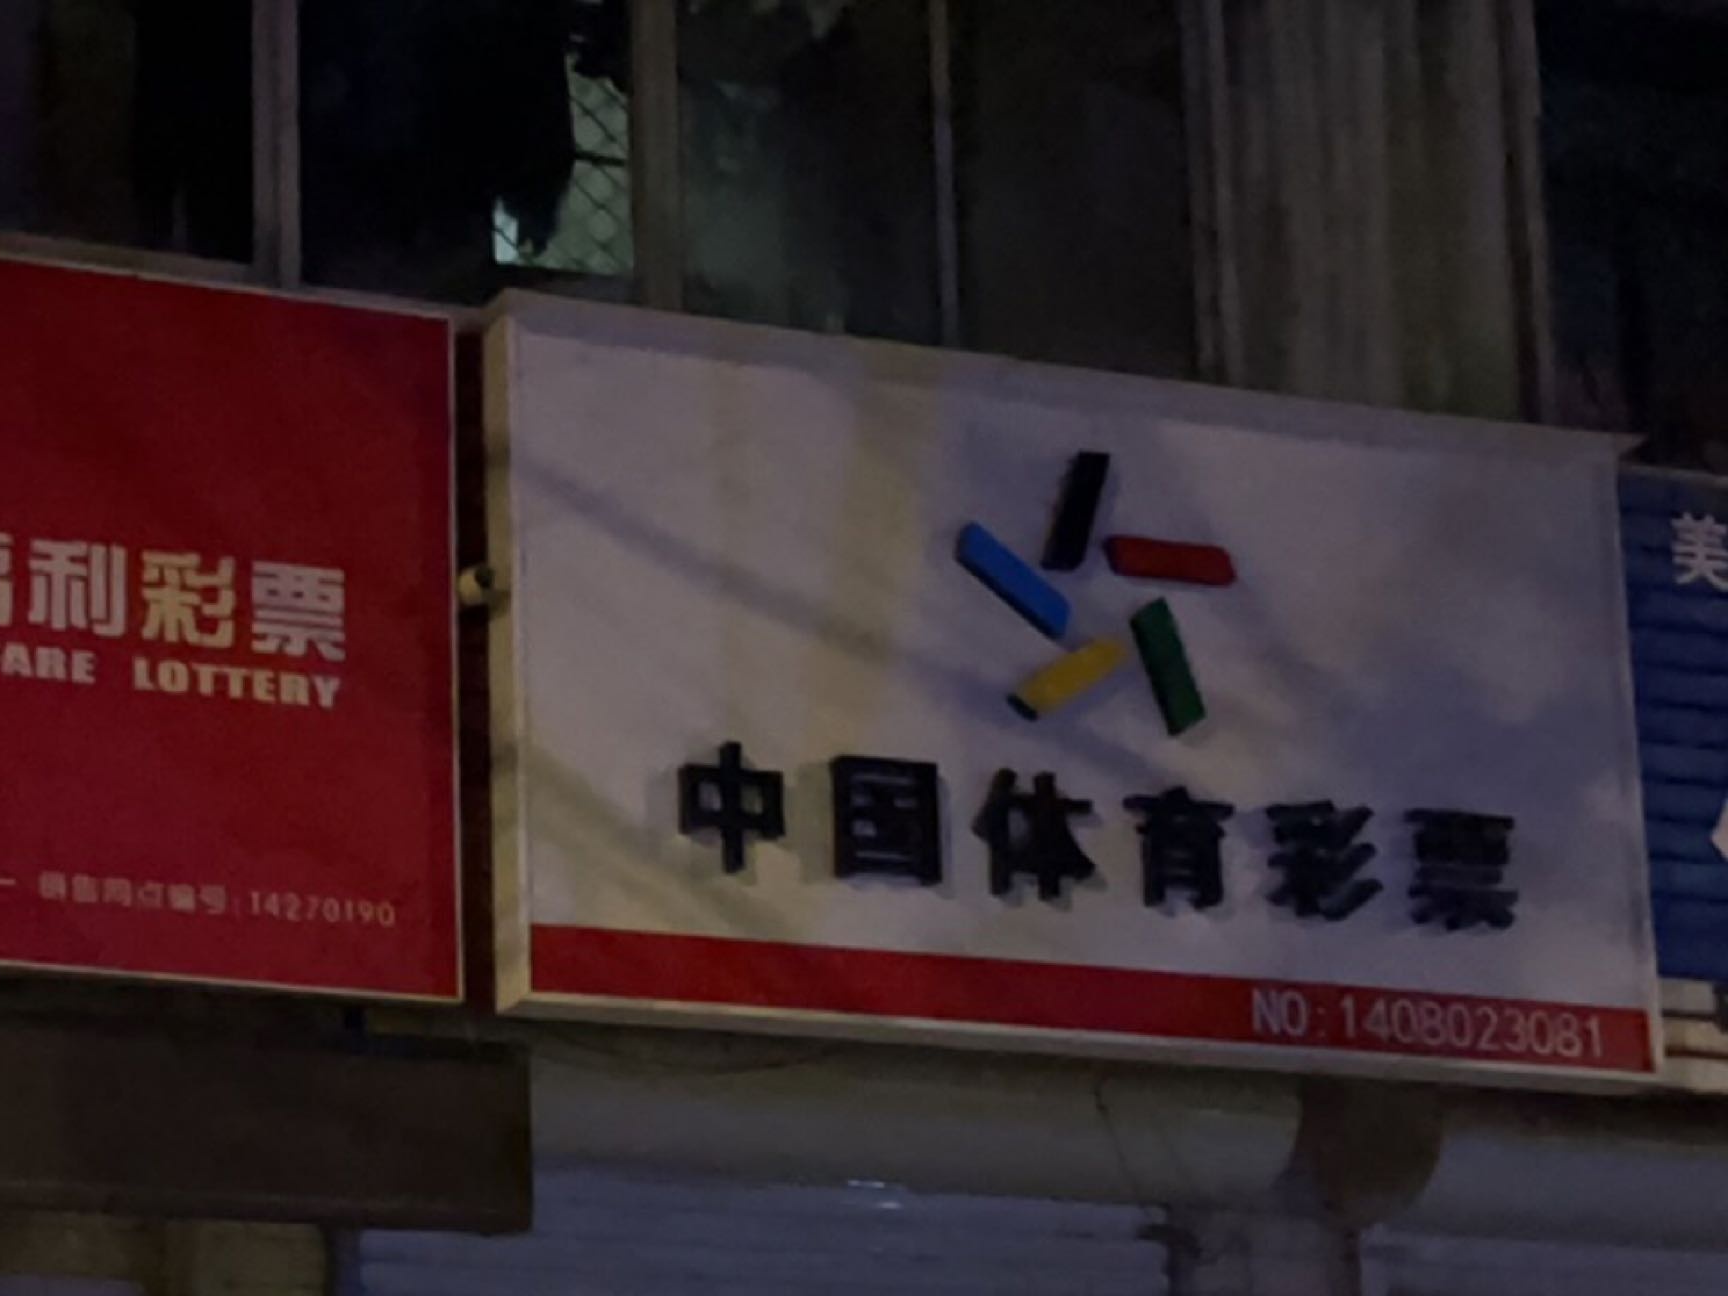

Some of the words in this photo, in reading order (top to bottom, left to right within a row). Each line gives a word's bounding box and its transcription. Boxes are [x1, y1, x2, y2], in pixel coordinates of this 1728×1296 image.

[113, 656, 342, 710] LOTTERY
[677, 741, 1519, 932] 中国体育彩票
